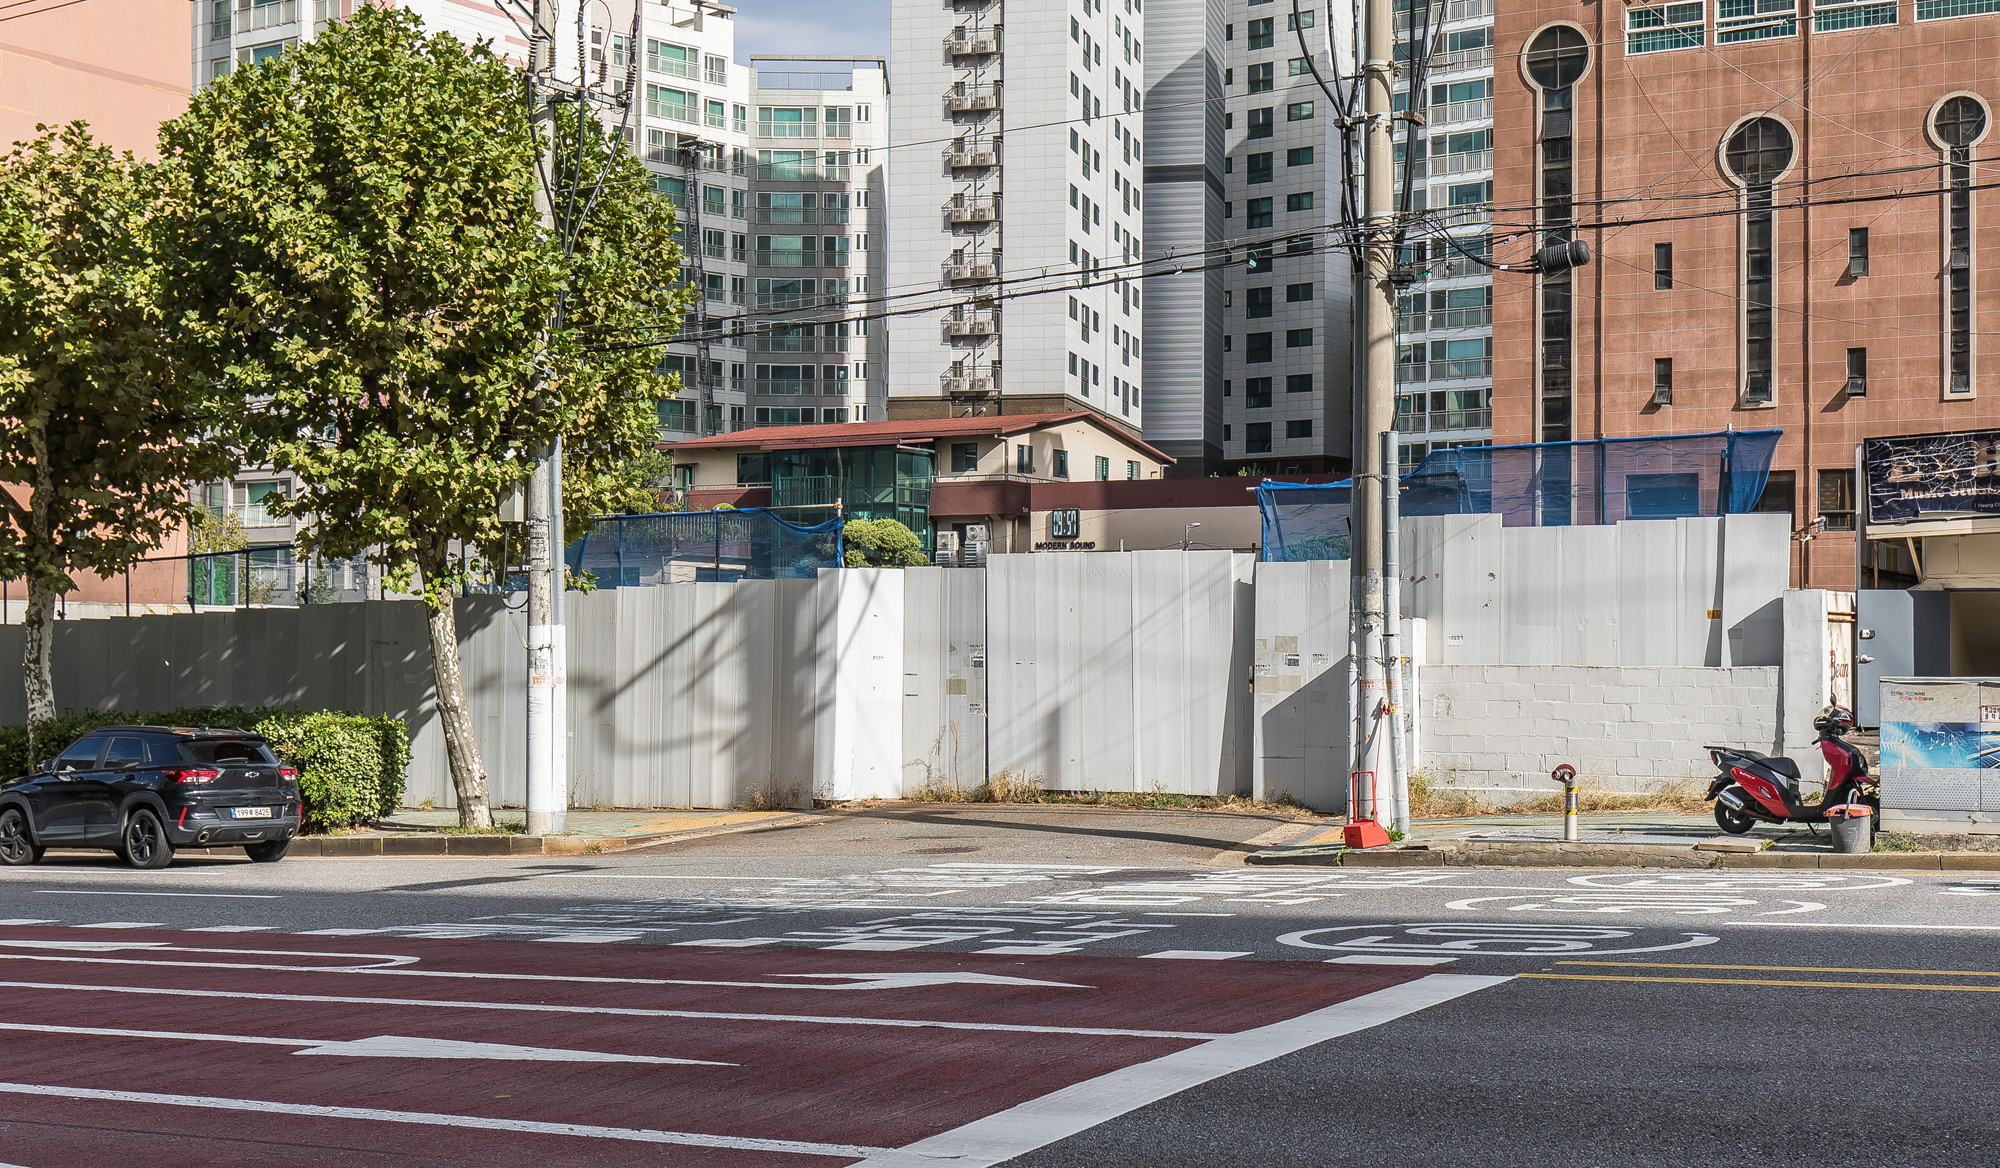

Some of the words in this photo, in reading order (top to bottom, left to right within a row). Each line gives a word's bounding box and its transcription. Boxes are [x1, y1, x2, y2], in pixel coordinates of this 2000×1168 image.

[1053, 510, 1077, 536] 09:57
[1035, 541, 1067, 551] MODERN
[1069, 541, 1096, 550] SOUND
[1829, 649, 1849, 682] Bean
[1336, 926, 1634, 951] 50
